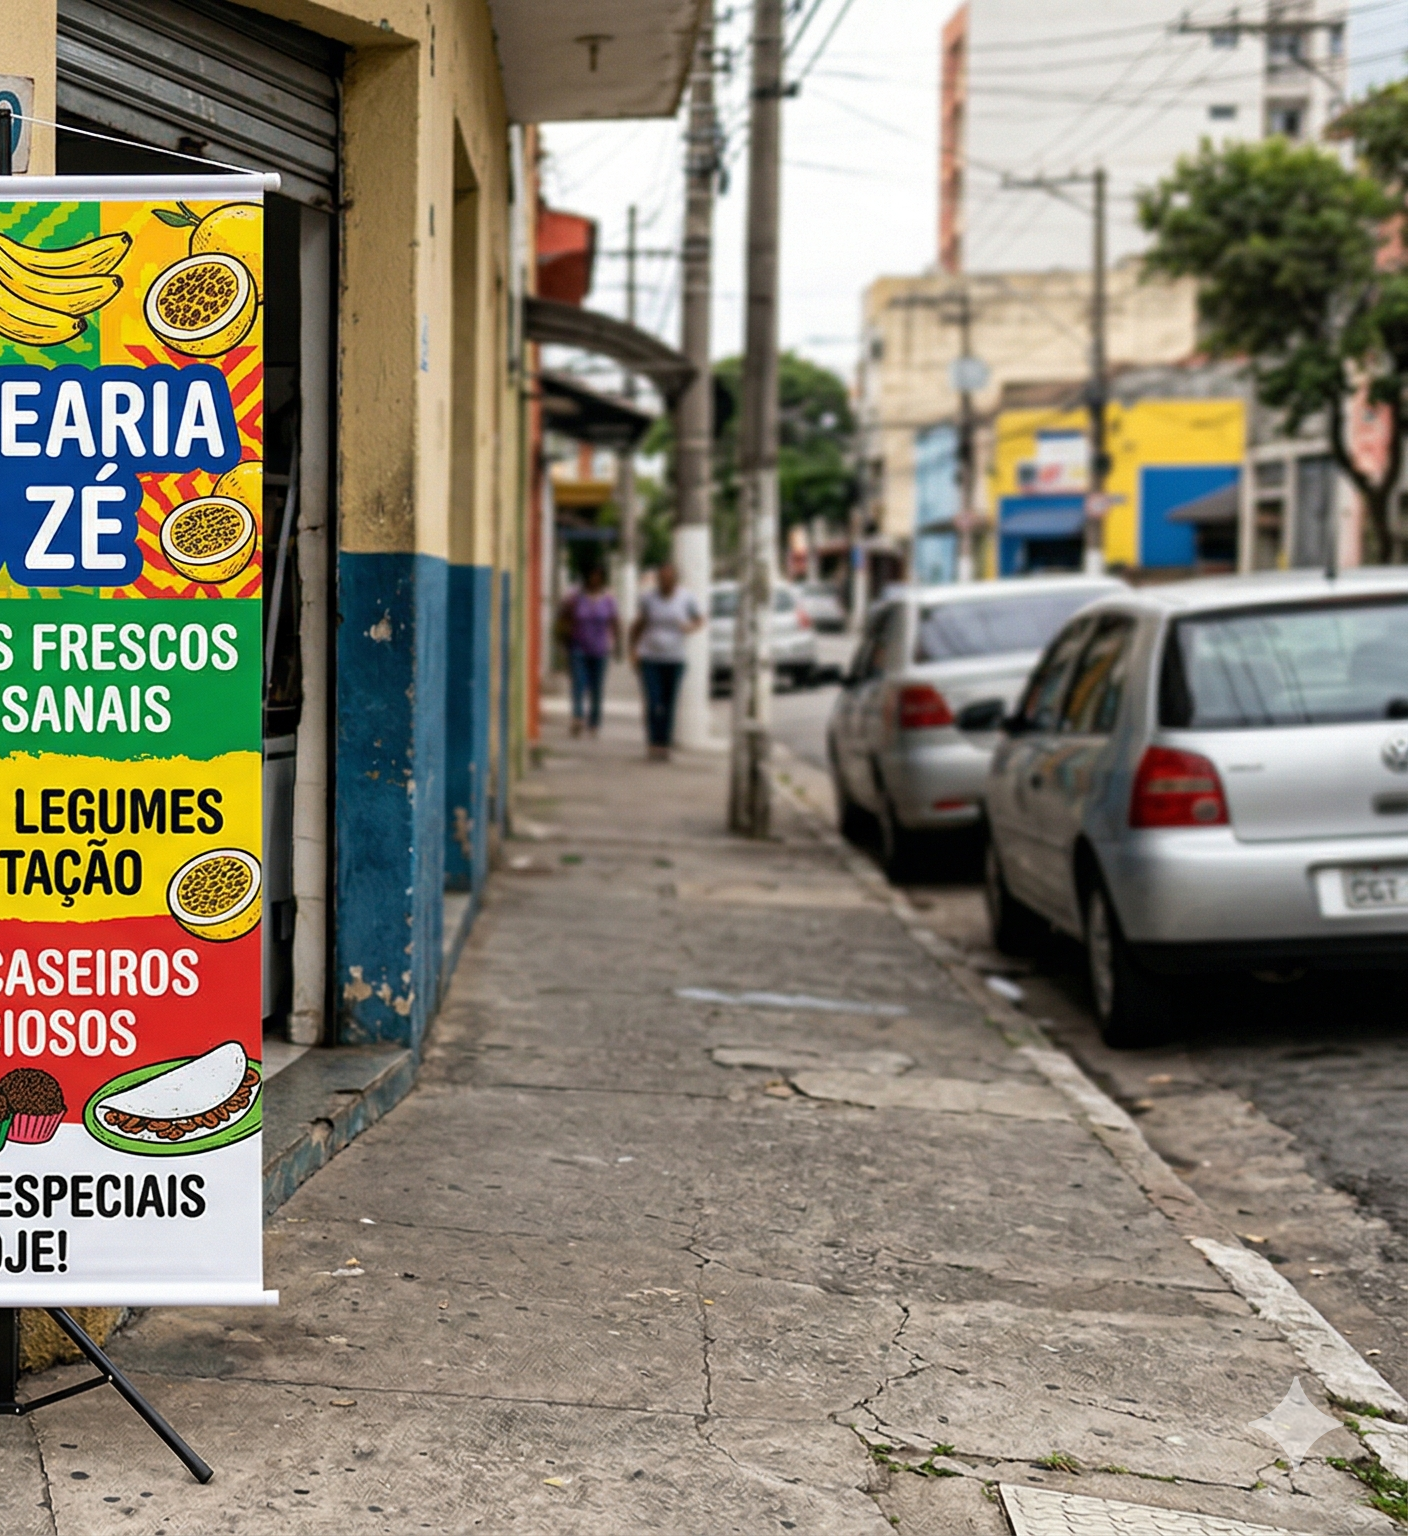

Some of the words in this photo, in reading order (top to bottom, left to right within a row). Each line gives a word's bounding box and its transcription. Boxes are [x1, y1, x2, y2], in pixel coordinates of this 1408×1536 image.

[24, 463, 127, 571] ZÉ
[33, 623, 239, 672] FRESCOS
[15, 788, 225, 836] LEGUMES
